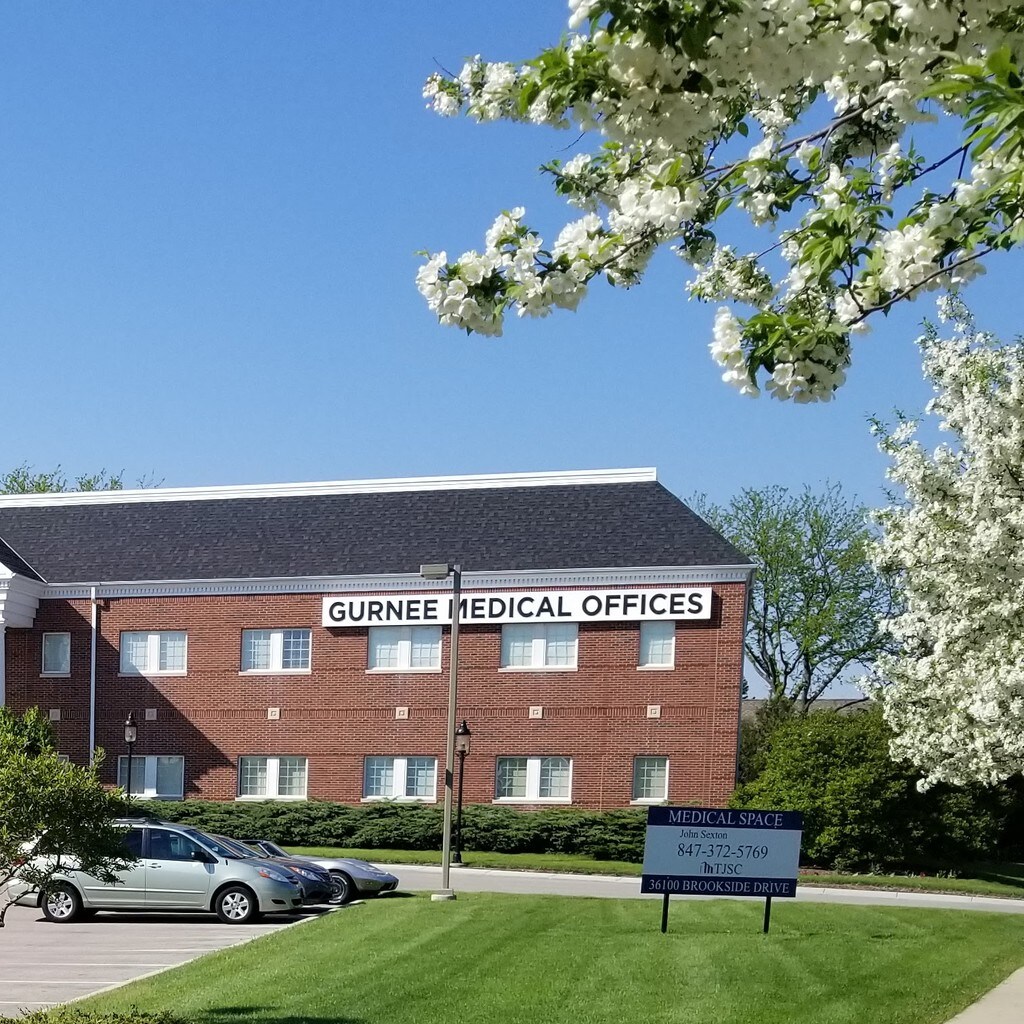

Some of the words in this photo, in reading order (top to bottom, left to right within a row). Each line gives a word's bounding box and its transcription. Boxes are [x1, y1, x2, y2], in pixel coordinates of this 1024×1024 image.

[328, 599, 438, 622] GURNEE
[448, 596, 572, 619] MEDICAL
[581, 592, 703, 616] OFFICES
[669, 809, 736, 825] MEDICAL
[739, 812, 784, 827] SPACE
[679, 829, 699, 839] John
[700, 830, 728, 840] Sexton
[677, 843, 769, 859] 847-372-5769
[648, 879, 680, 891] 36100
[682, 880, 751, 893] BROOKSIDE
[753, 881, 790, 894] DRIVE
